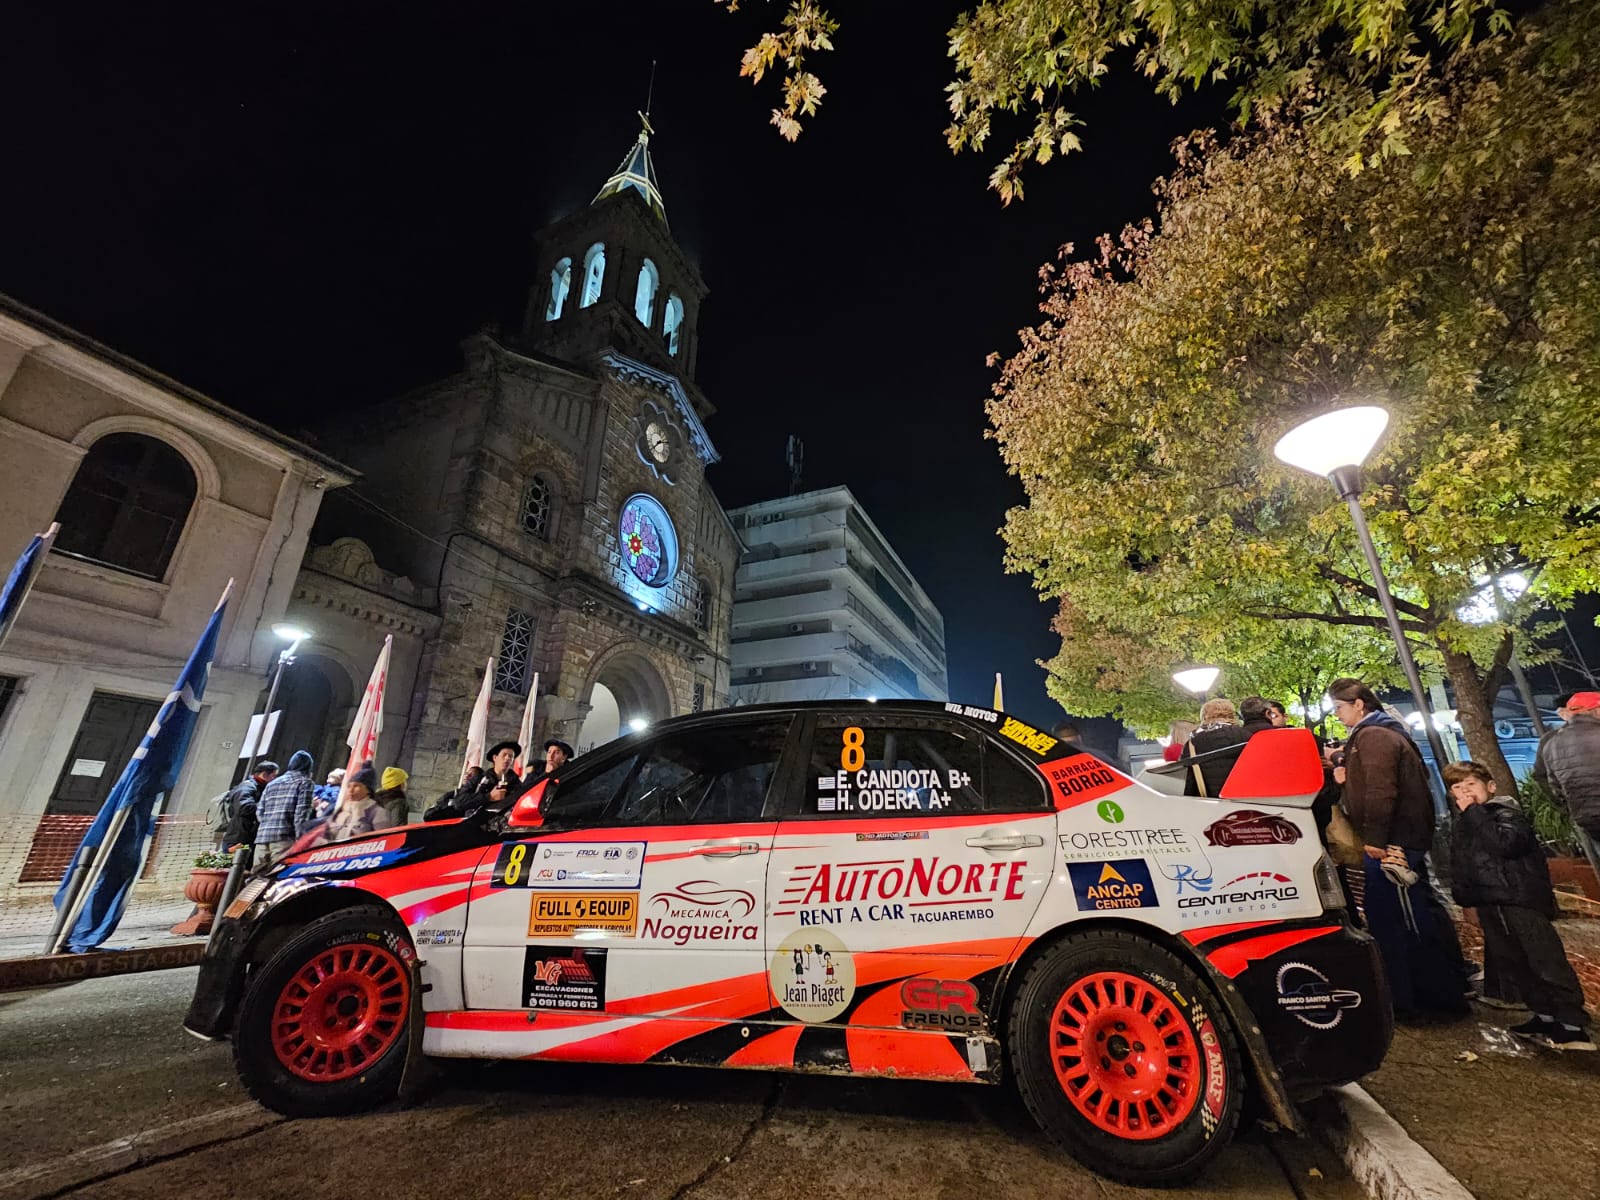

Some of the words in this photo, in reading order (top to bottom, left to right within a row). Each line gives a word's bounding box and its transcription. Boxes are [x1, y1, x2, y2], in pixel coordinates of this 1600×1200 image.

[944, 702, 963, 715] WIL
[964, 706, 998, 723] MOTOS
[999, 726, 1048, 756] SUAREZ
[1003, 717, 1058, 747] VINILOS
[841, 727, 865, 772] 8
[837, 769, 852, 789] E.
[856, 769, 942, 789] CANDIOTA
[948, 769, 971, 789] B+
[1051, 760, 1102, 781] BARRACA
[1057, 769, 1114, 797] BORAD
[837, 789, 854, 811] H.
[858, 789, 921, 811] ODERA
[928, 789, 951, 809] A+
[307, 840, 387, 864] PINTURERIA
[604, 849, 621, 859] FIA
[1063, 850, 1121, 859] SERVICIOS
[1124, 847, 1192, 857] FORESTALES
[288, 861, 348, 877] PUNTO
[344, 855, 383, 871] DOS
[504, 844, 527, 886] 8
[1087, 883, 1144, 899] ANCAP
[538, 901, 571, 916] FULL
[589, 900, 630, 916] EQUIP
[671, 907, 730, 918] MECÁNICA
[1095, 898, 1142, 909] CENTRO
[1181, 902, 1277, 918] REPUESTOS
[800, 907, 844, 926] RENT
[850, 906, 863, 922] A
[868, 904, 905, 922] CAR
[910, 908, 994, 924] TACUAREMBO
[534, 924, 562, 933] REPUESTOS
[641, 918, 758, 946] Nogueira
[48, 961, 87, 979] NO
[535, 985, 594, 993] EXCAVACIONES
[783, 983, 808, 1003] Jean
[811, 983, 845, 1007] Piaget
[902, 979, 979, 1014] GR
[1305, 995, 1330, 1003] SANTOS
[538, 998, 556, 1006] 091
[580, 1000, 598, 1009] 613
[903, 1012, 981, 1027] FRENOS
[1207, 1049, 1225, 1103] MRF
